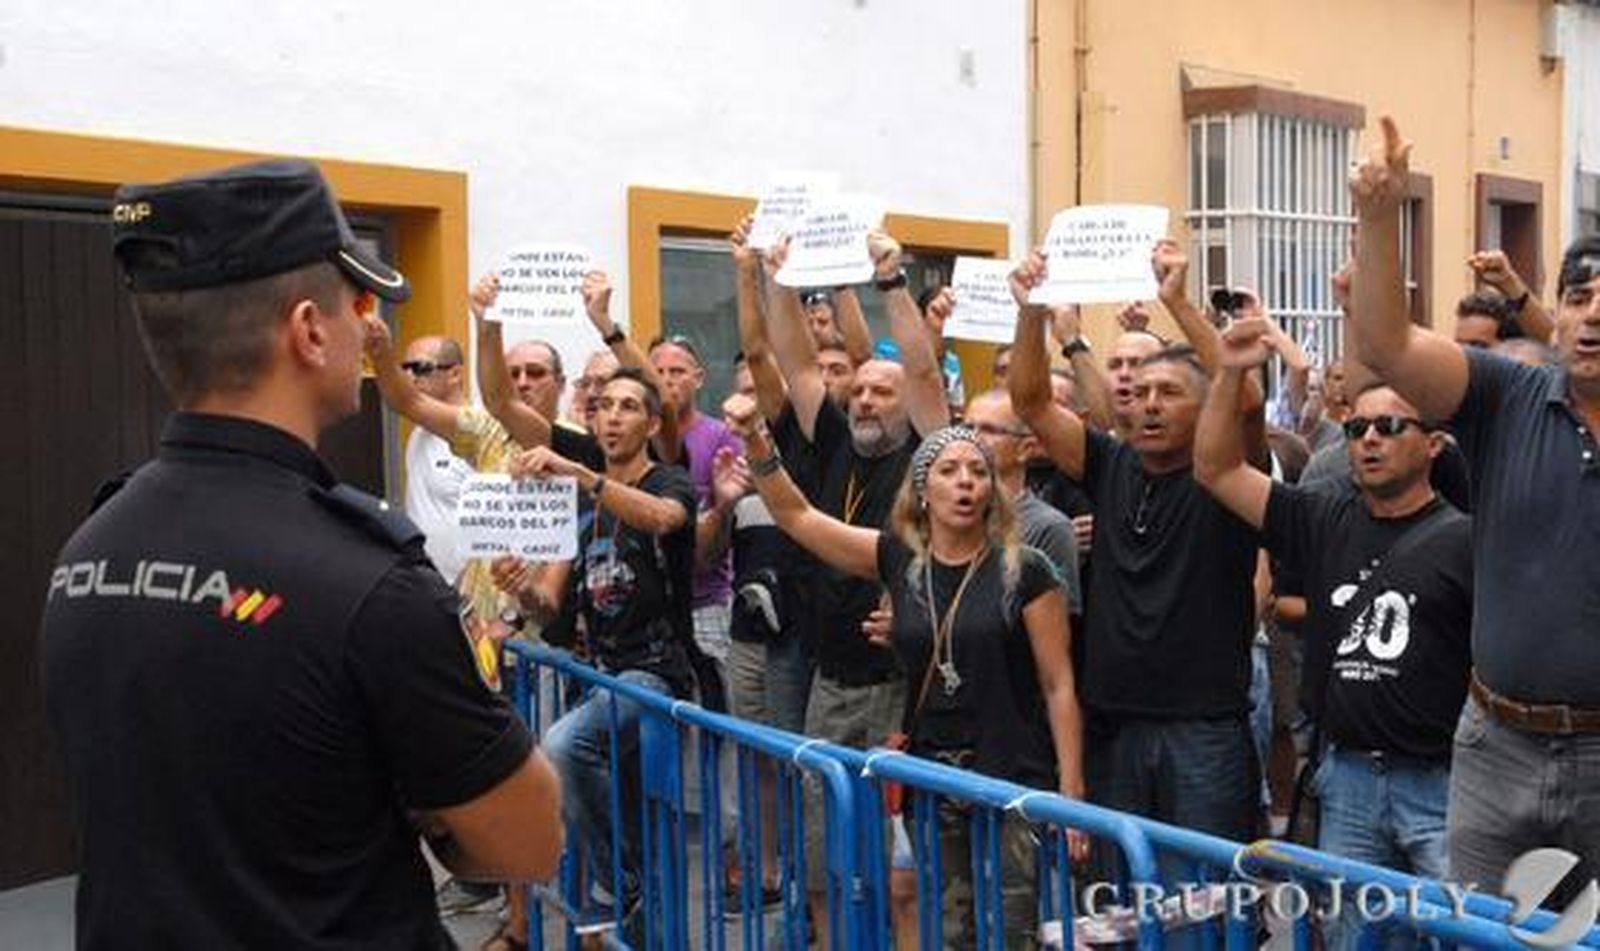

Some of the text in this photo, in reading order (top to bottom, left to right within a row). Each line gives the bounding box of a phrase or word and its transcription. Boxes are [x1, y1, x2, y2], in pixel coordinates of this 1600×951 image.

[486, 499, 502, 511] SE
[507, 500, 537, 511] VEN
[541, 499, 568, 511] LOS
[521, 517, 548, 529] DEL
[49, 560, 233, 617] POLICIA
